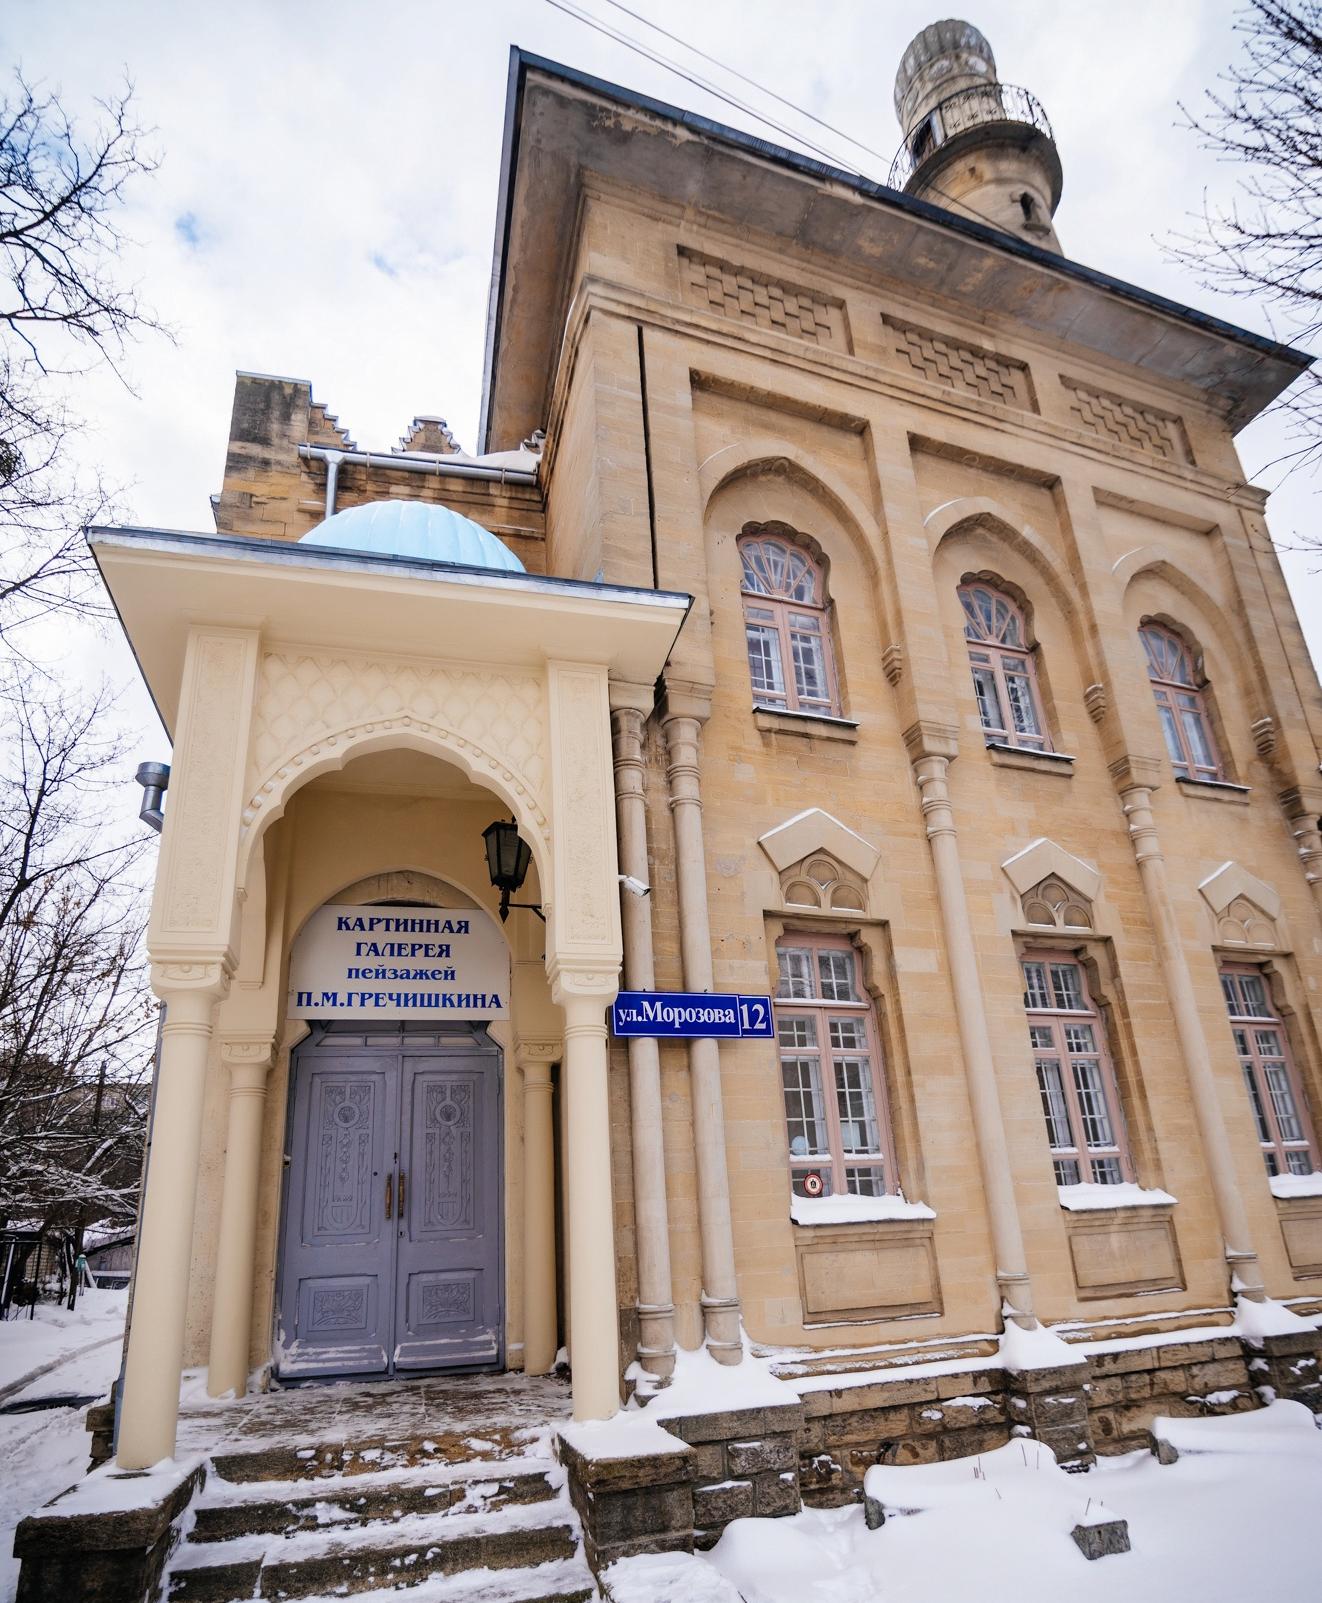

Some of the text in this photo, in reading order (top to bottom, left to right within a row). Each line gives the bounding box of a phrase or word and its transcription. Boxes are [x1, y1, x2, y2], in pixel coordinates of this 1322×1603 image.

[336, 916, 471, 935] КАРТИННАЯ
[355, 942, 452, 958] ГАЛЕРЕЯ
[347, 964, 457, 981] пейзажей
[296, 991, 504, 1009] П.М.ГРЕЧИШКИНА
[618, 1000, 767, 1030] ул.Морозова 12
